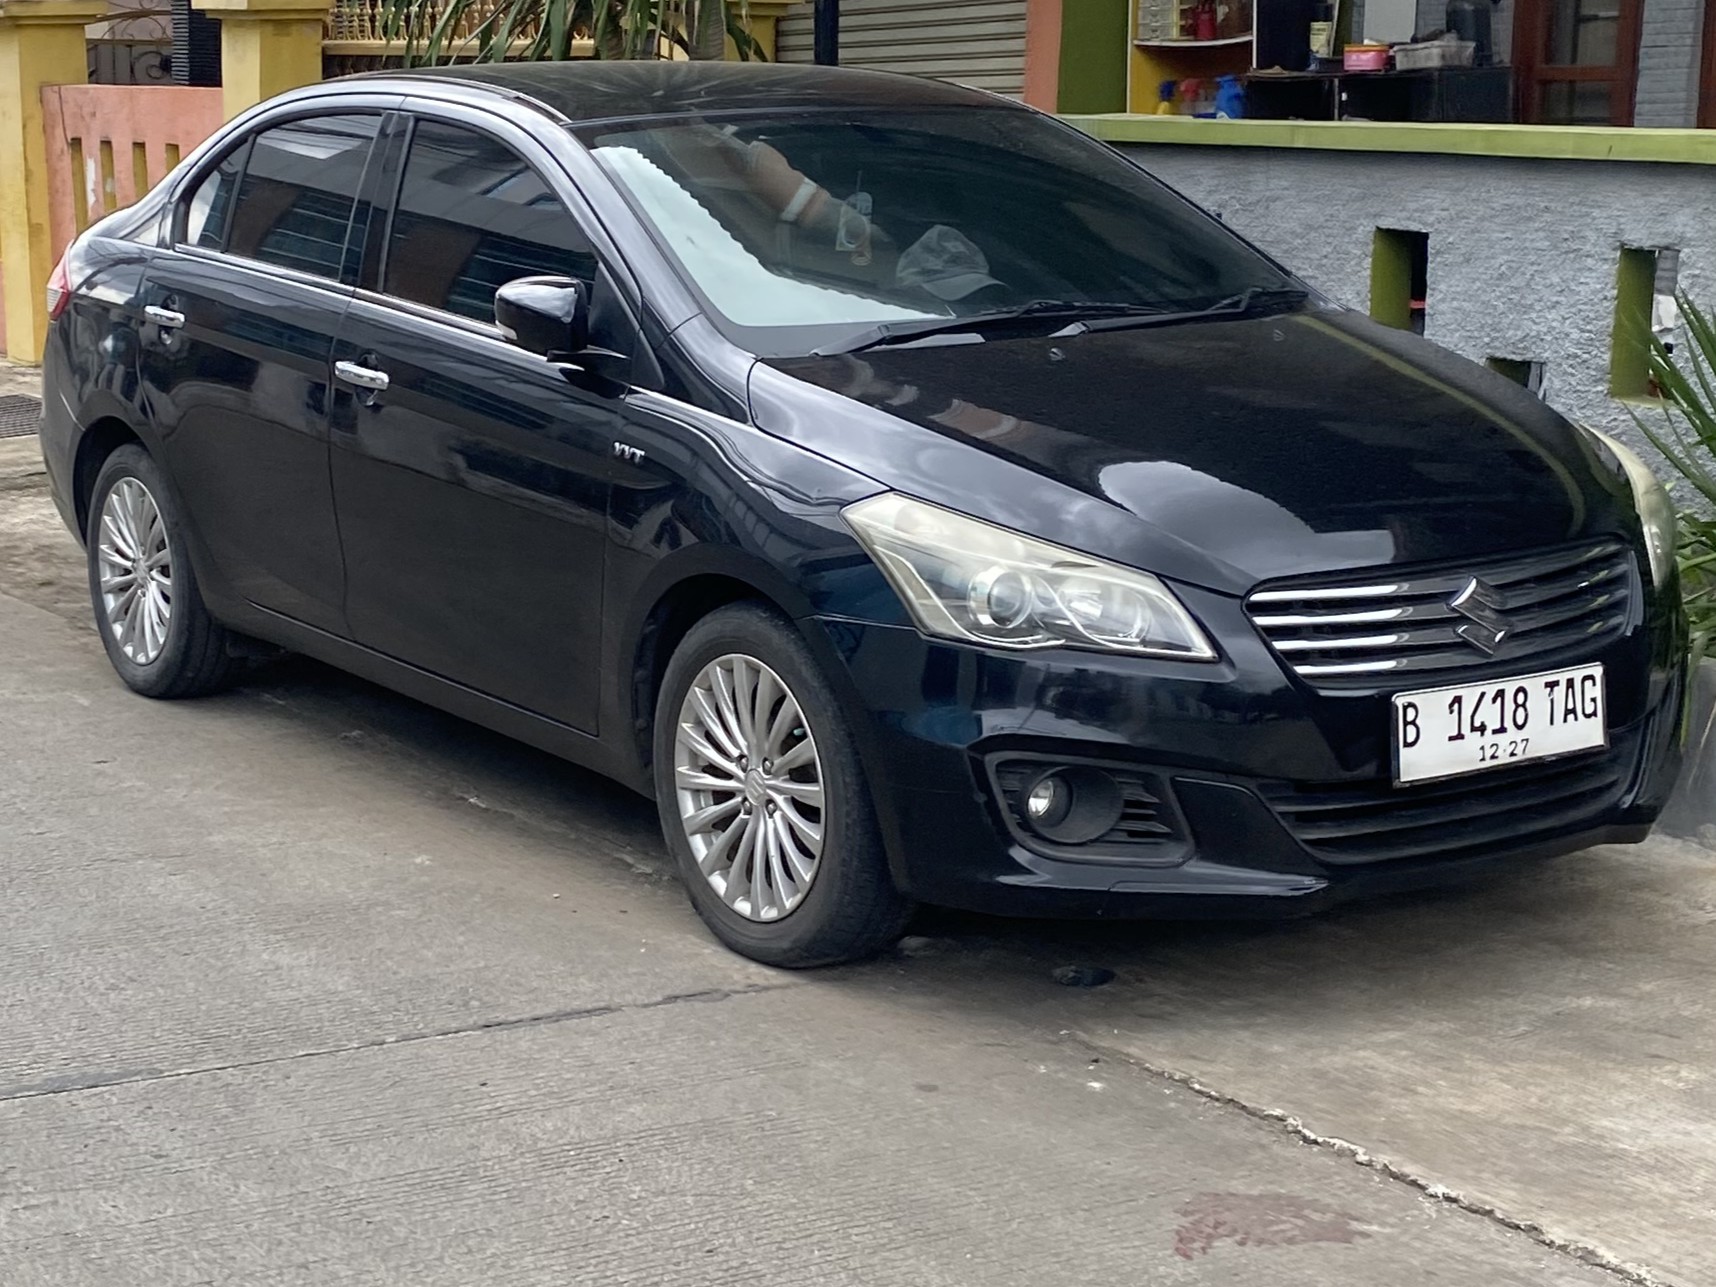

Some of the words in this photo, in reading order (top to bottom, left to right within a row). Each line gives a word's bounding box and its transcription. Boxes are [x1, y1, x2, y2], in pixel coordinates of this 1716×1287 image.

[1402, 702, 1420, 748] B
[1448, 686, 1529, 742] 1418
[1544, 674, 1598, 726] TAG
